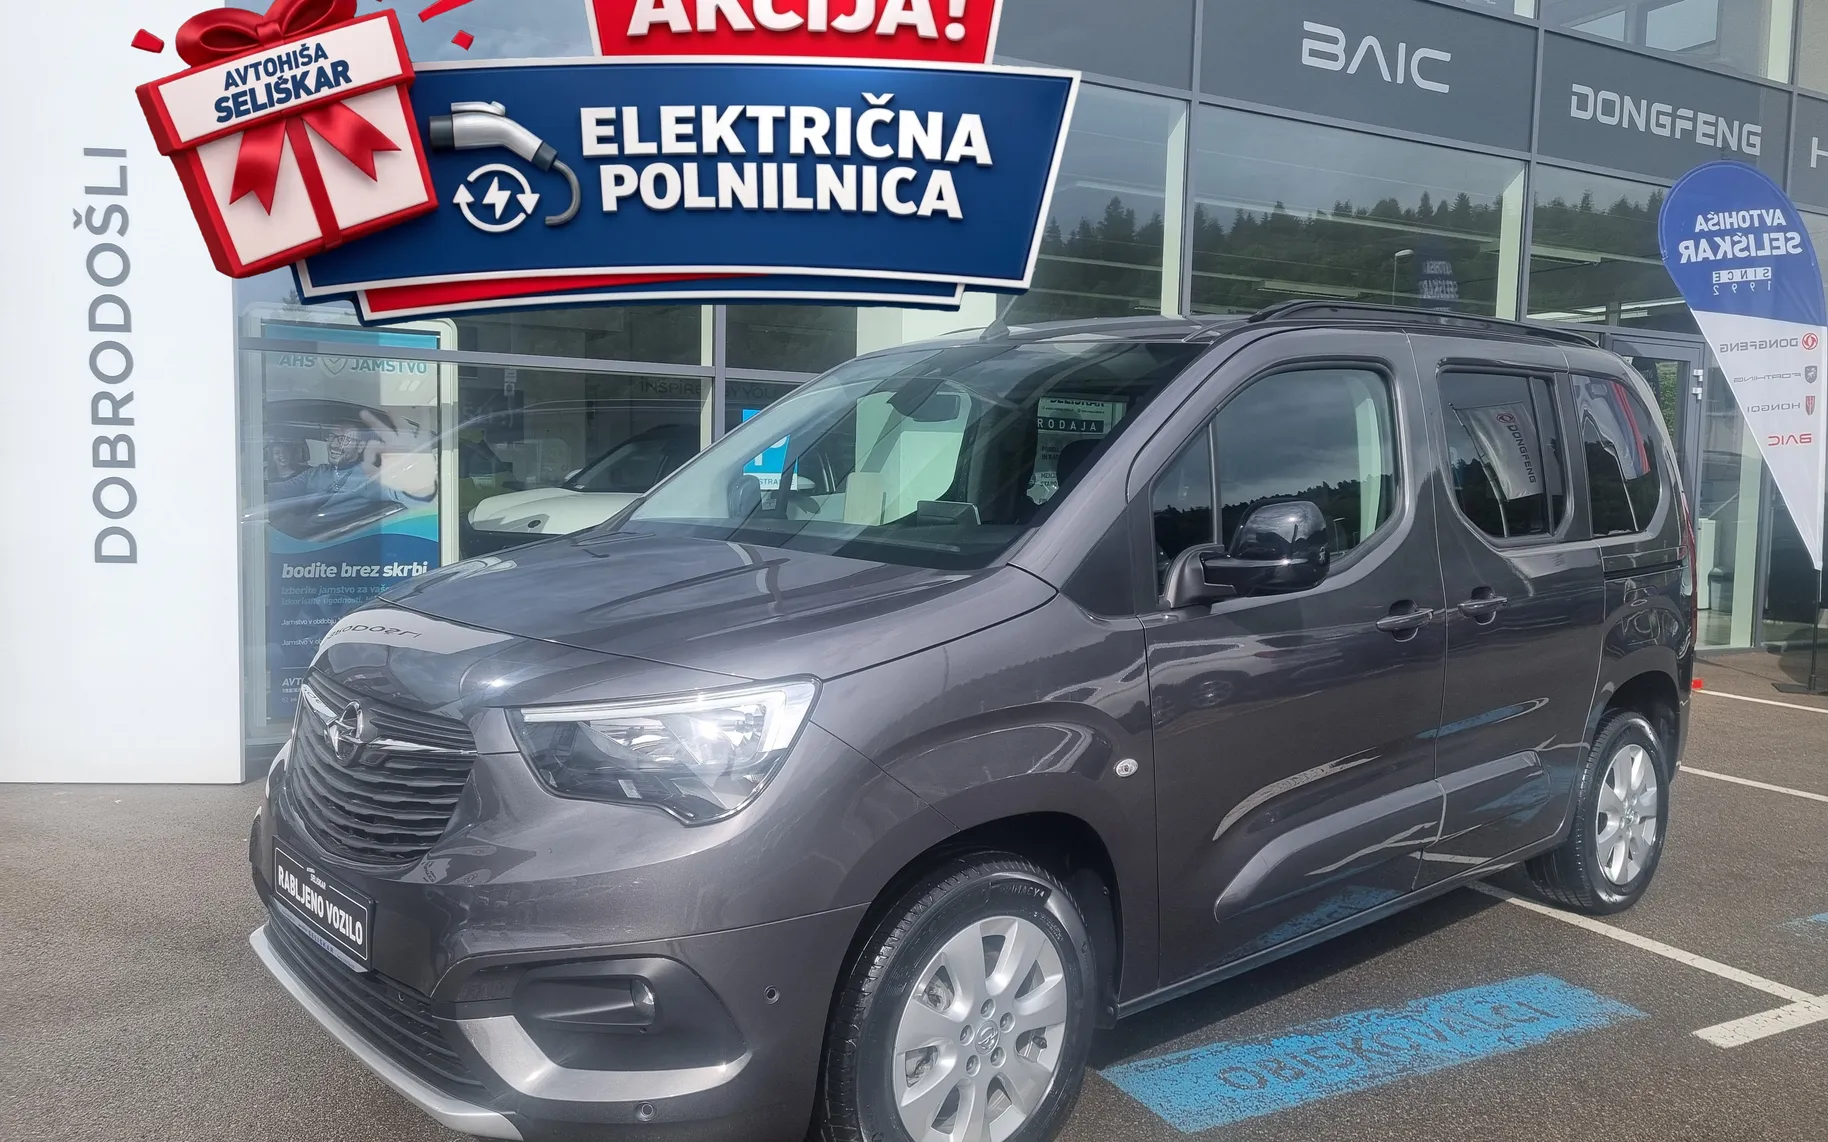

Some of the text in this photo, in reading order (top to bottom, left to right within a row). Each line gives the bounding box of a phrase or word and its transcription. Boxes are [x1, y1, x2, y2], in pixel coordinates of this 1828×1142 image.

[1301, 20, 1452, 94] BAIC
[1570, 83, 1763, 156] DONGFENG
[73, 147, 138, 564] DOBRODOŠLI
[279, 354, 427, 375] AHS JAMSTVO
[1037, 418, 1097, 431] RODAJA
[1506, 424, 1537, 484] DONGFENG
[282, 561, 428, 578] bodite brez skrbi
[281, 585, 316, 594] Izberite
[318, 585, 355, 596] jamstvo
[281, 618, 308, 626] Jamstvo
[313, 617, 337, 626] obdobju
[281, 677, 303, 687] AVT
[278, 865, 363, 945] RABLJENO VOZILO
